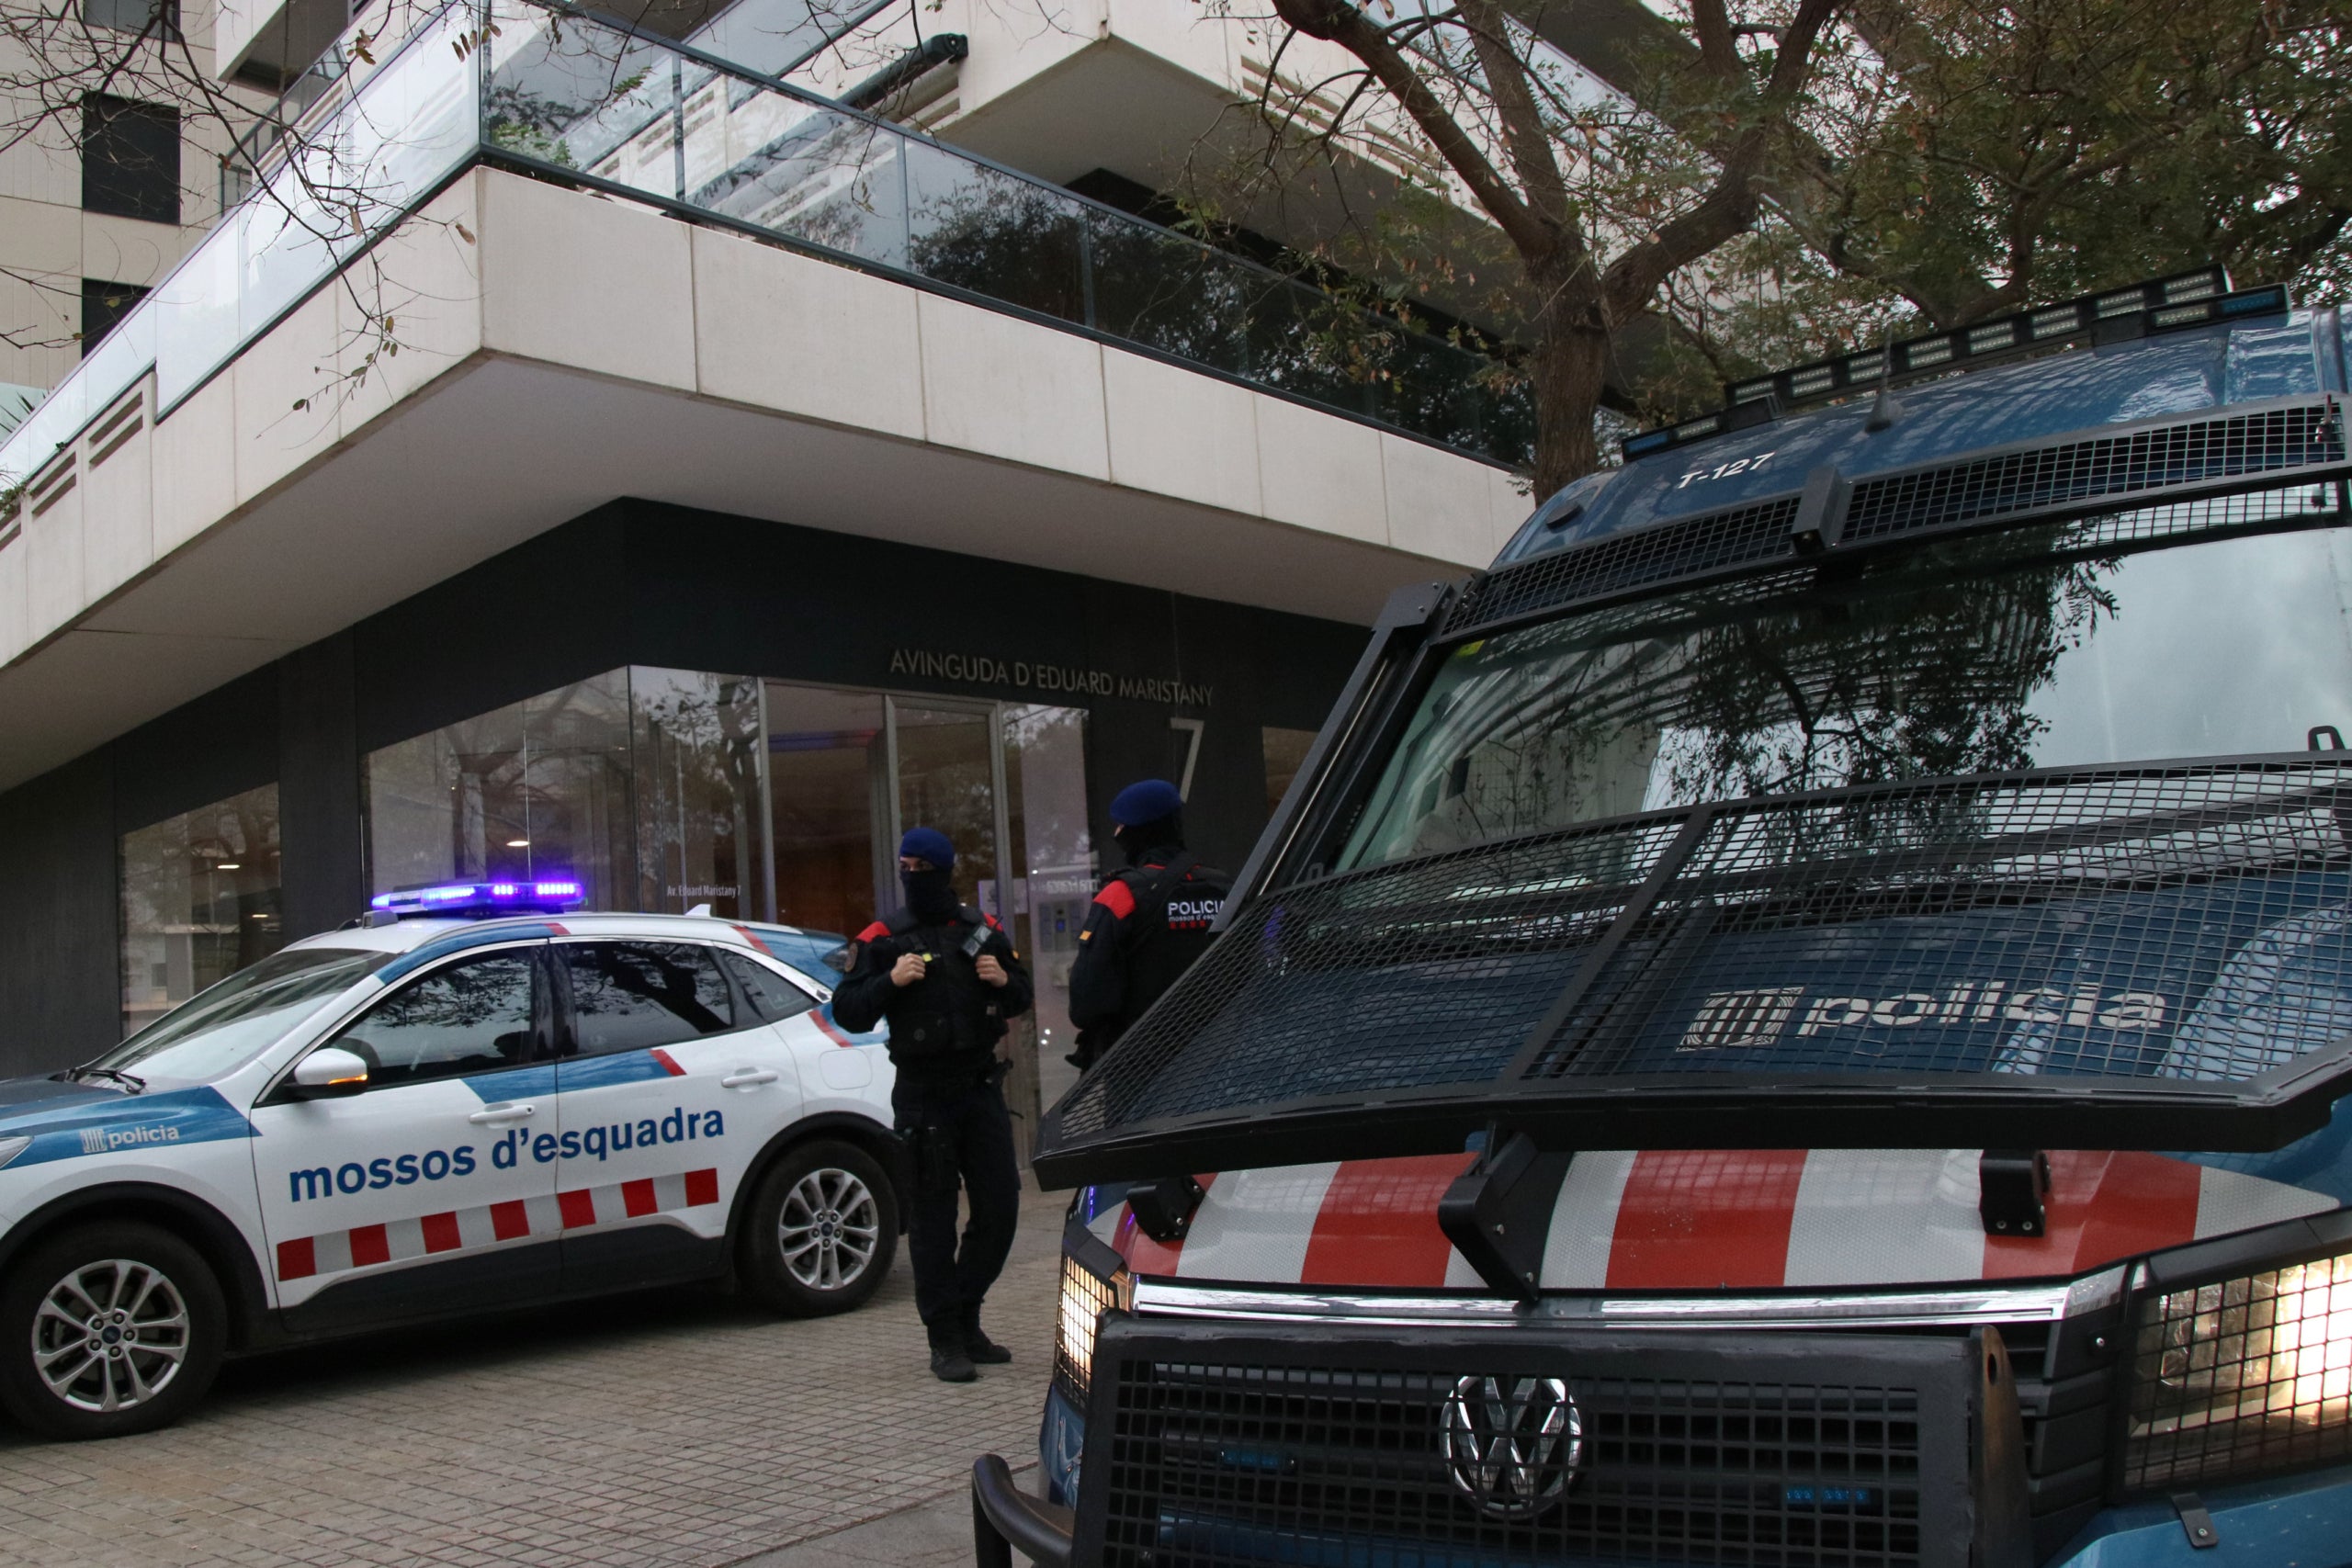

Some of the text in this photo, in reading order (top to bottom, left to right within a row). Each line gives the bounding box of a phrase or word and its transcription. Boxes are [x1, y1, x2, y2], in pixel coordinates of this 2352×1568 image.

[1678, 451, 1776, 490] T-127
[890, 649, 1214, 706] AVINGUDA D'EDUARD MARISTANY
[1170, 716, 1204, 804] 7
[667, 885, 677, 897] Av.
[679, 885, 702, 897] Eduard
[703, 885, 736, 898] Maristany
[1795, 981, 2167, 1039] policia
[107, 1124, 180, 1149] policia
[289, 1107, 725, 1202] mossos d'esquadra
